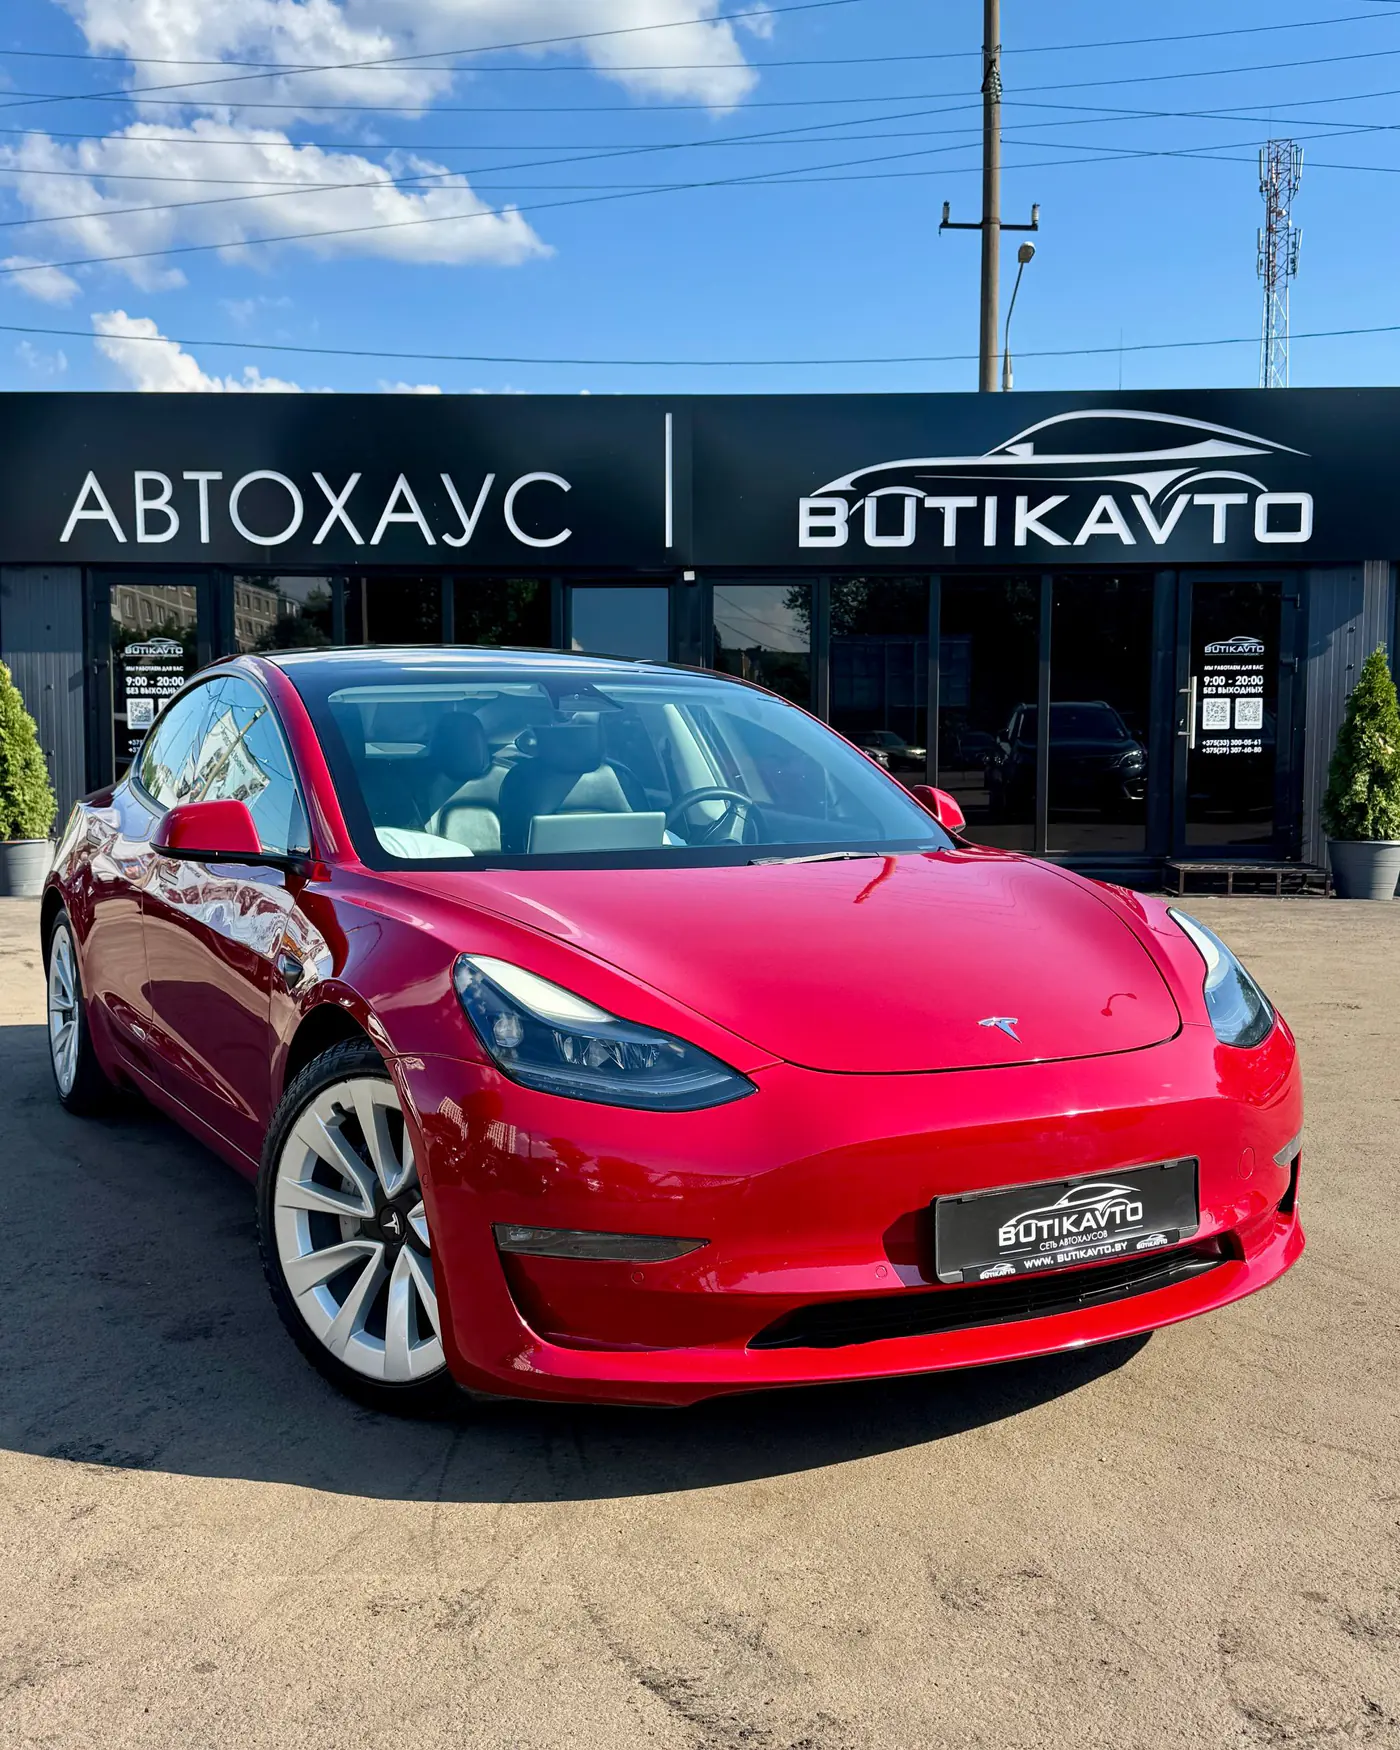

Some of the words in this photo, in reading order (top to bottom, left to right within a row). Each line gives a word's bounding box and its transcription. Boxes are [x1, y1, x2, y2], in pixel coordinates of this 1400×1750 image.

[59, 469, 572, 548] АВТОХАУС
[798, 492, 1313, 548] BUTIKAVTO
[125, 646, 183, 655] BUTIKAVTO
[1204, 645, 1264, 653] BUTIKAVTO
[126, 676, 147, 686] 9:00
[157, 676, 184, 686] 20:00
[1204, 676, 1225, 686] 9:00
[1235, 675, 1264, 685] 20:00
[126, 687, 139, 695] БЕЗ
[1217, 686, 1263, 694] ВЫХОДНЫХ
[1201, 739, 1229, 747] +375(33)
[998, 1202, 1143, 1247] BUTIKAVTO
[1039, 1239, 1058, 1251] СЕТЬ
[1059, 1229, 1108, 1248] АВТОХАУСОВ
[1136, 1238, 1168, 1250] BUTIKAVTO
[1023, 1257, 1054, 1269] WWW.
[1057, 1242, 1128, 1263] BUTIKAVTO.BY
[979, 1267, 1016, 1280] BUTIKAVTO
